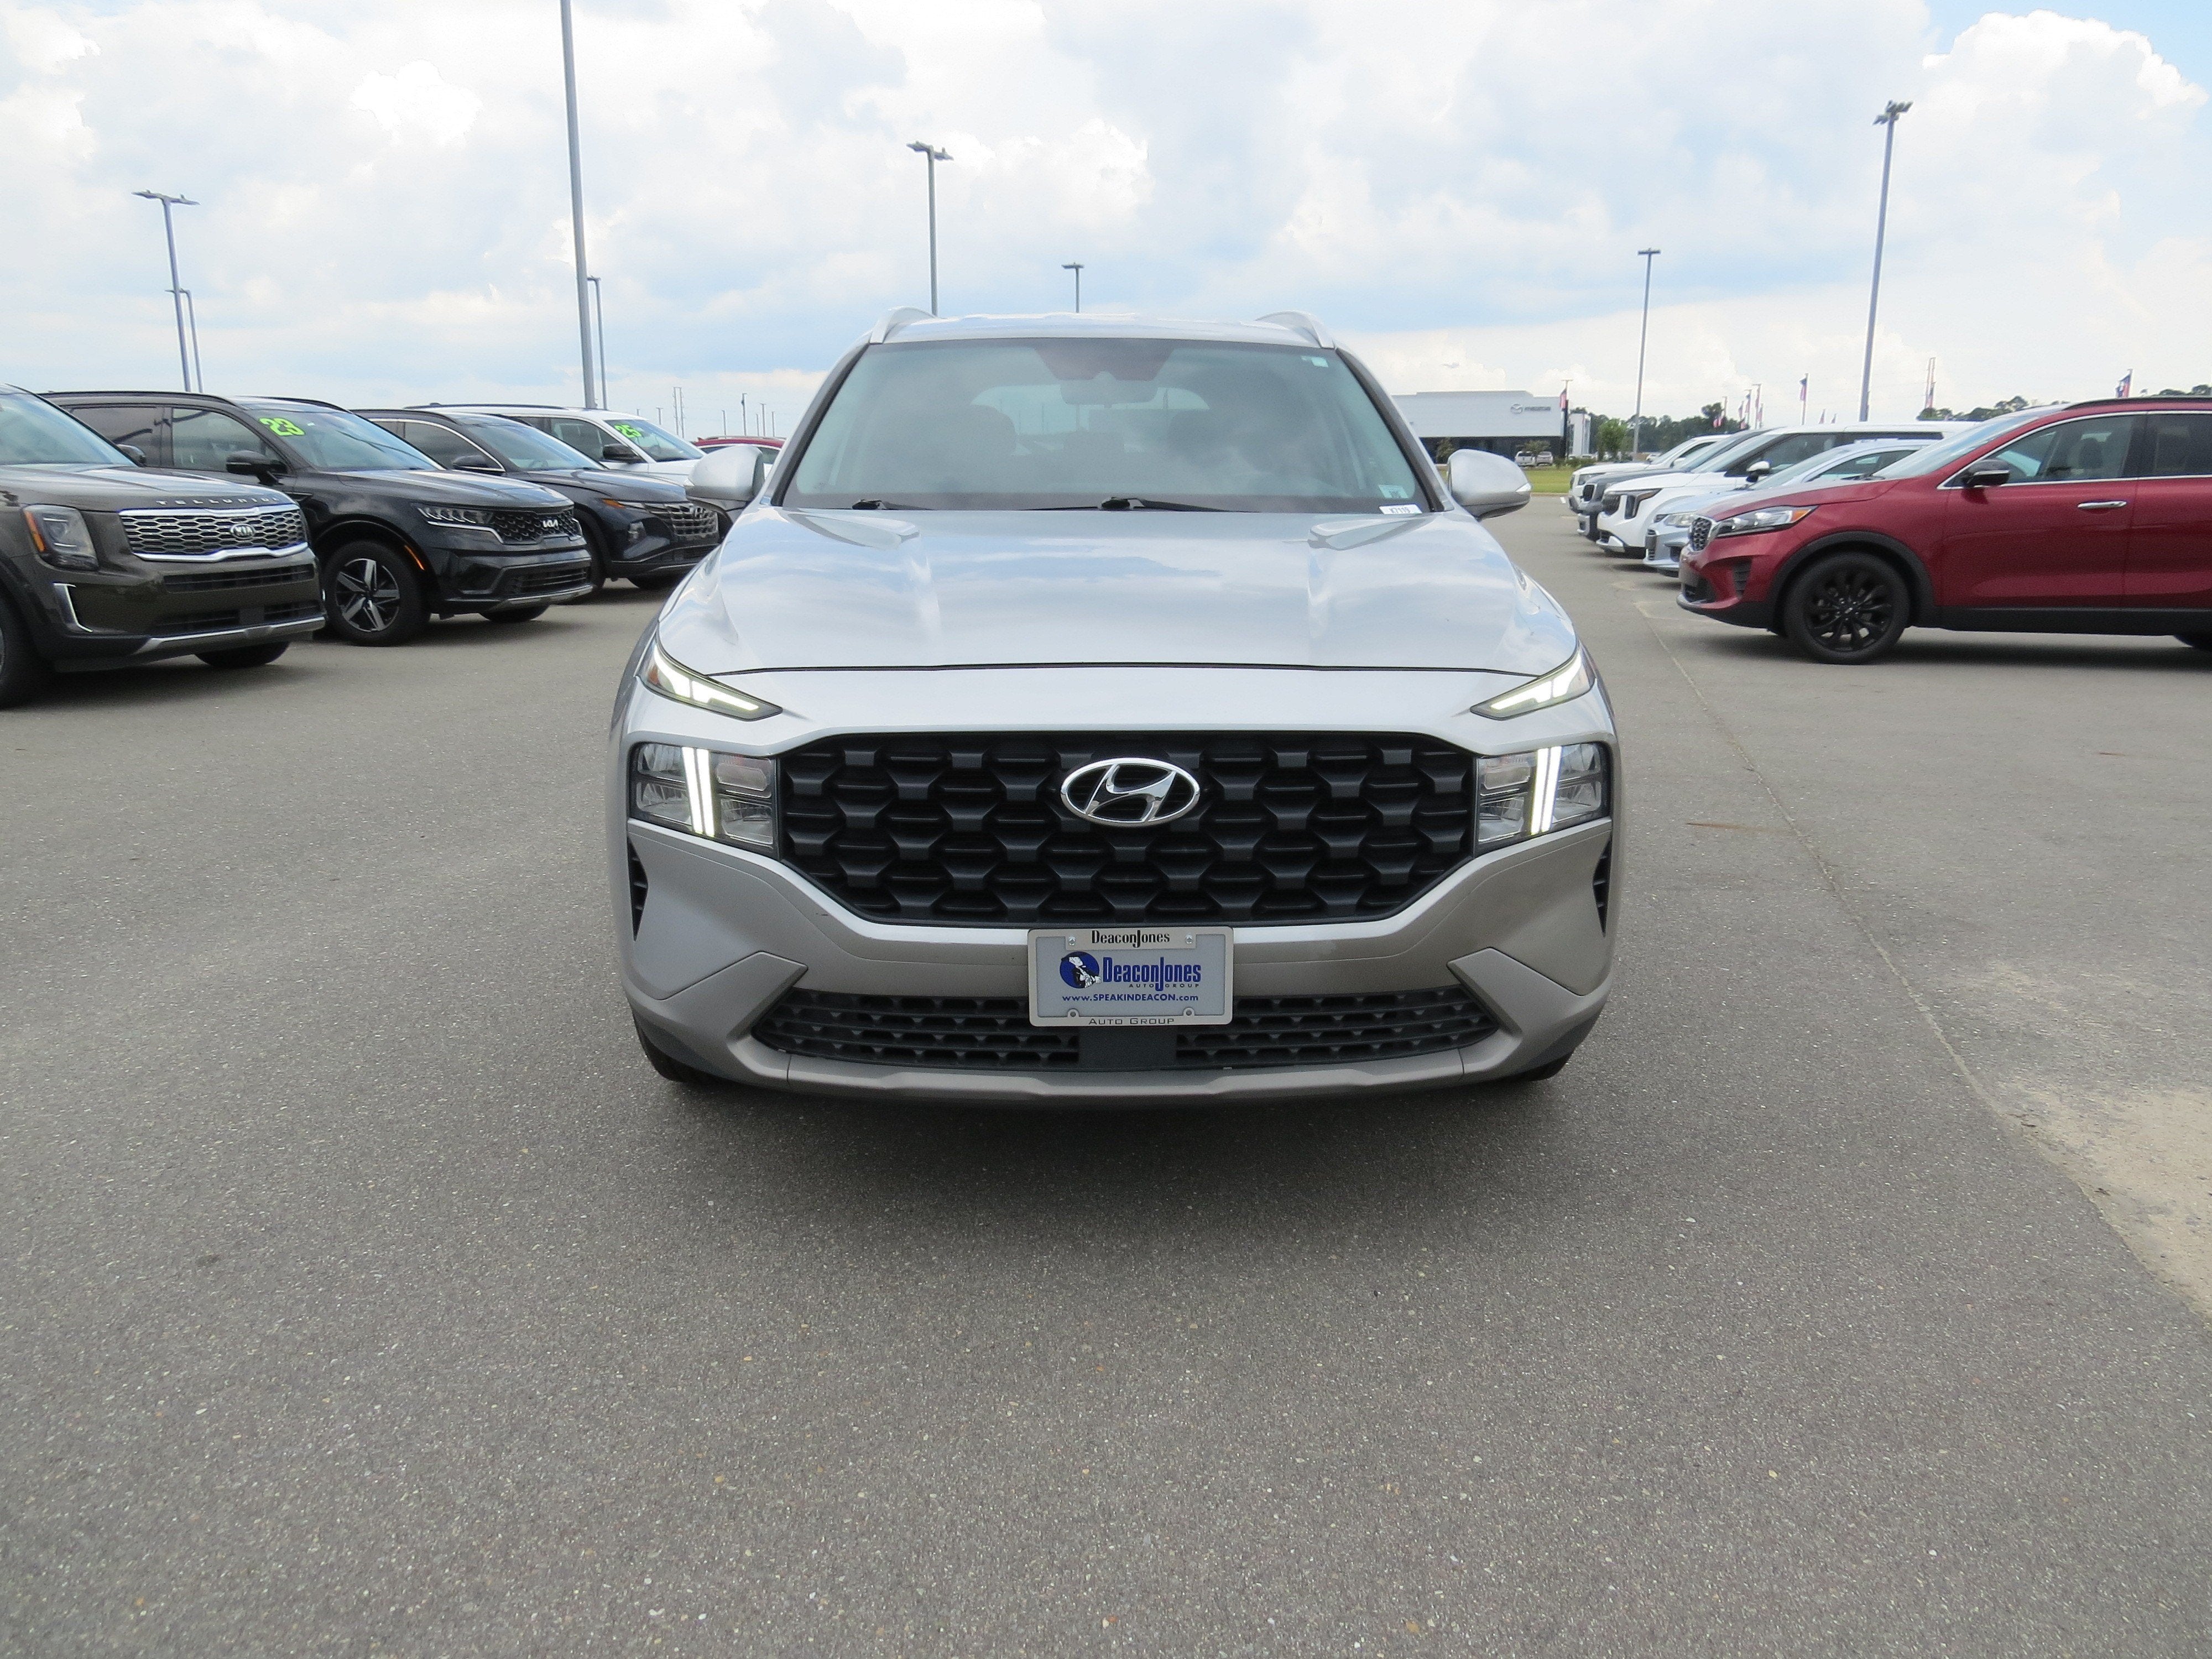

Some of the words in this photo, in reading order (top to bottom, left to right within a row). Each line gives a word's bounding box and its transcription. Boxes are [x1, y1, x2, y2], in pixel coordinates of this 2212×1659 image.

[259, 417, 305, 436] 23
[614, 423, 641, 437] 25
[233, 525, 254, 537] KIA
[1062, 993, 1199, 1001] www.SPEAKINDEACON.com
